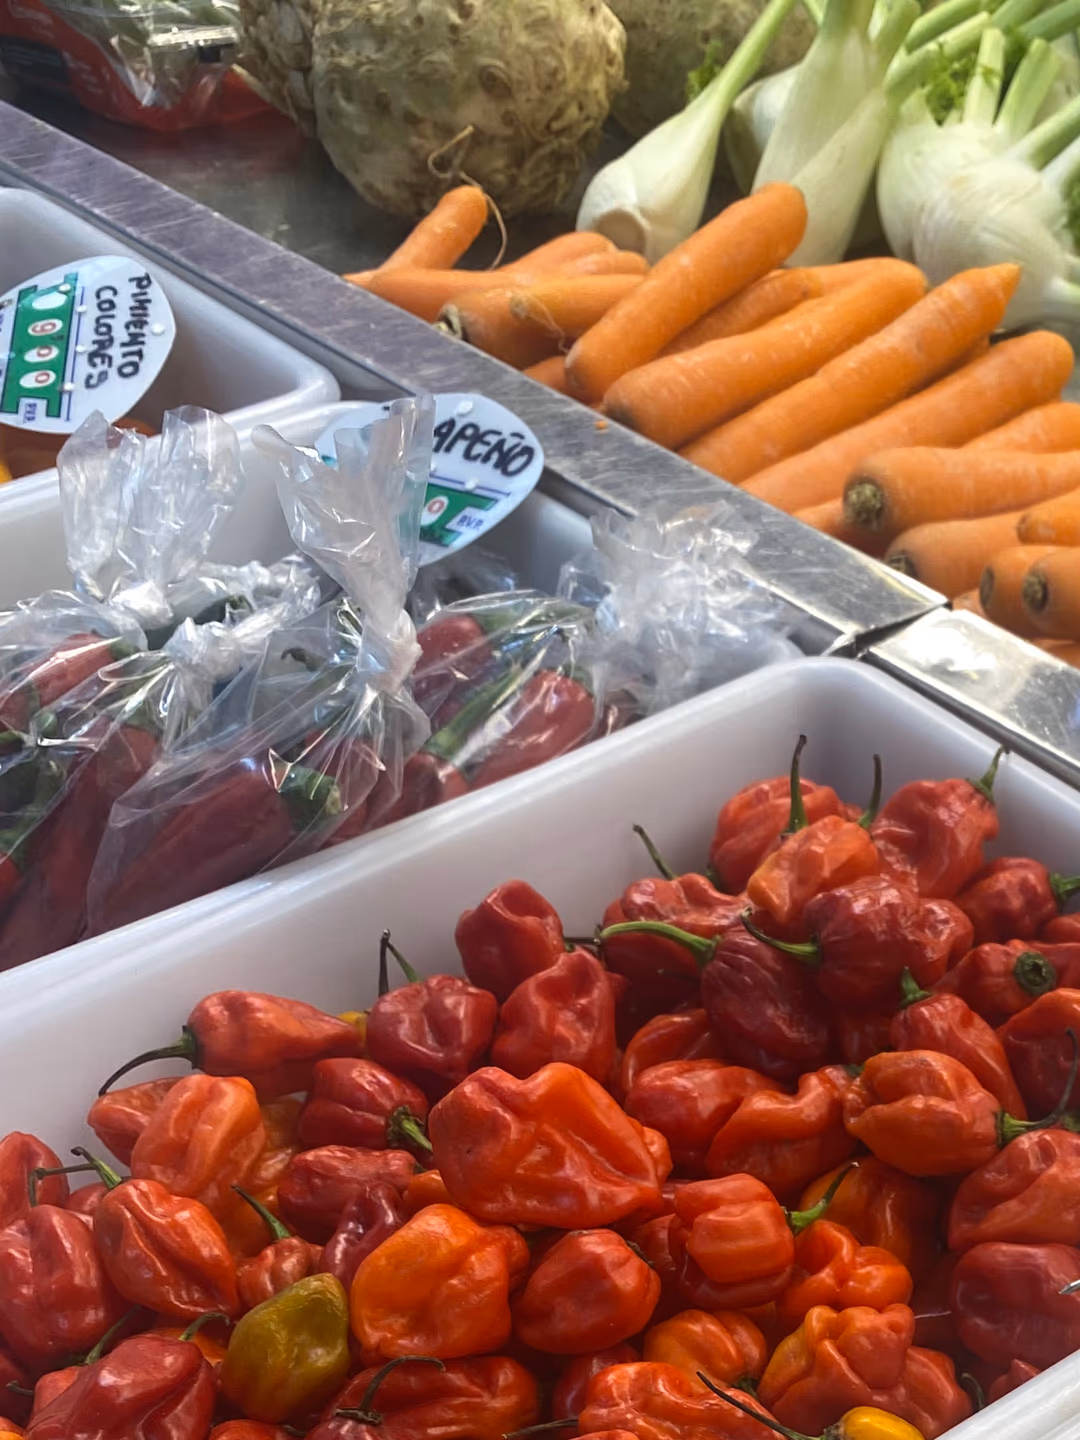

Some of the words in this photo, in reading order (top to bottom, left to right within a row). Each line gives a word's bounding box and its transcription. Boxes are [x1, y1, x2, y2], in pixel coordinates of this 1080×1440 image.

[84, 285, 118, 390] COLORES
[117, 272, 152, 379] PIMIENTO
[432, 418, 535, 477] APEÑO
